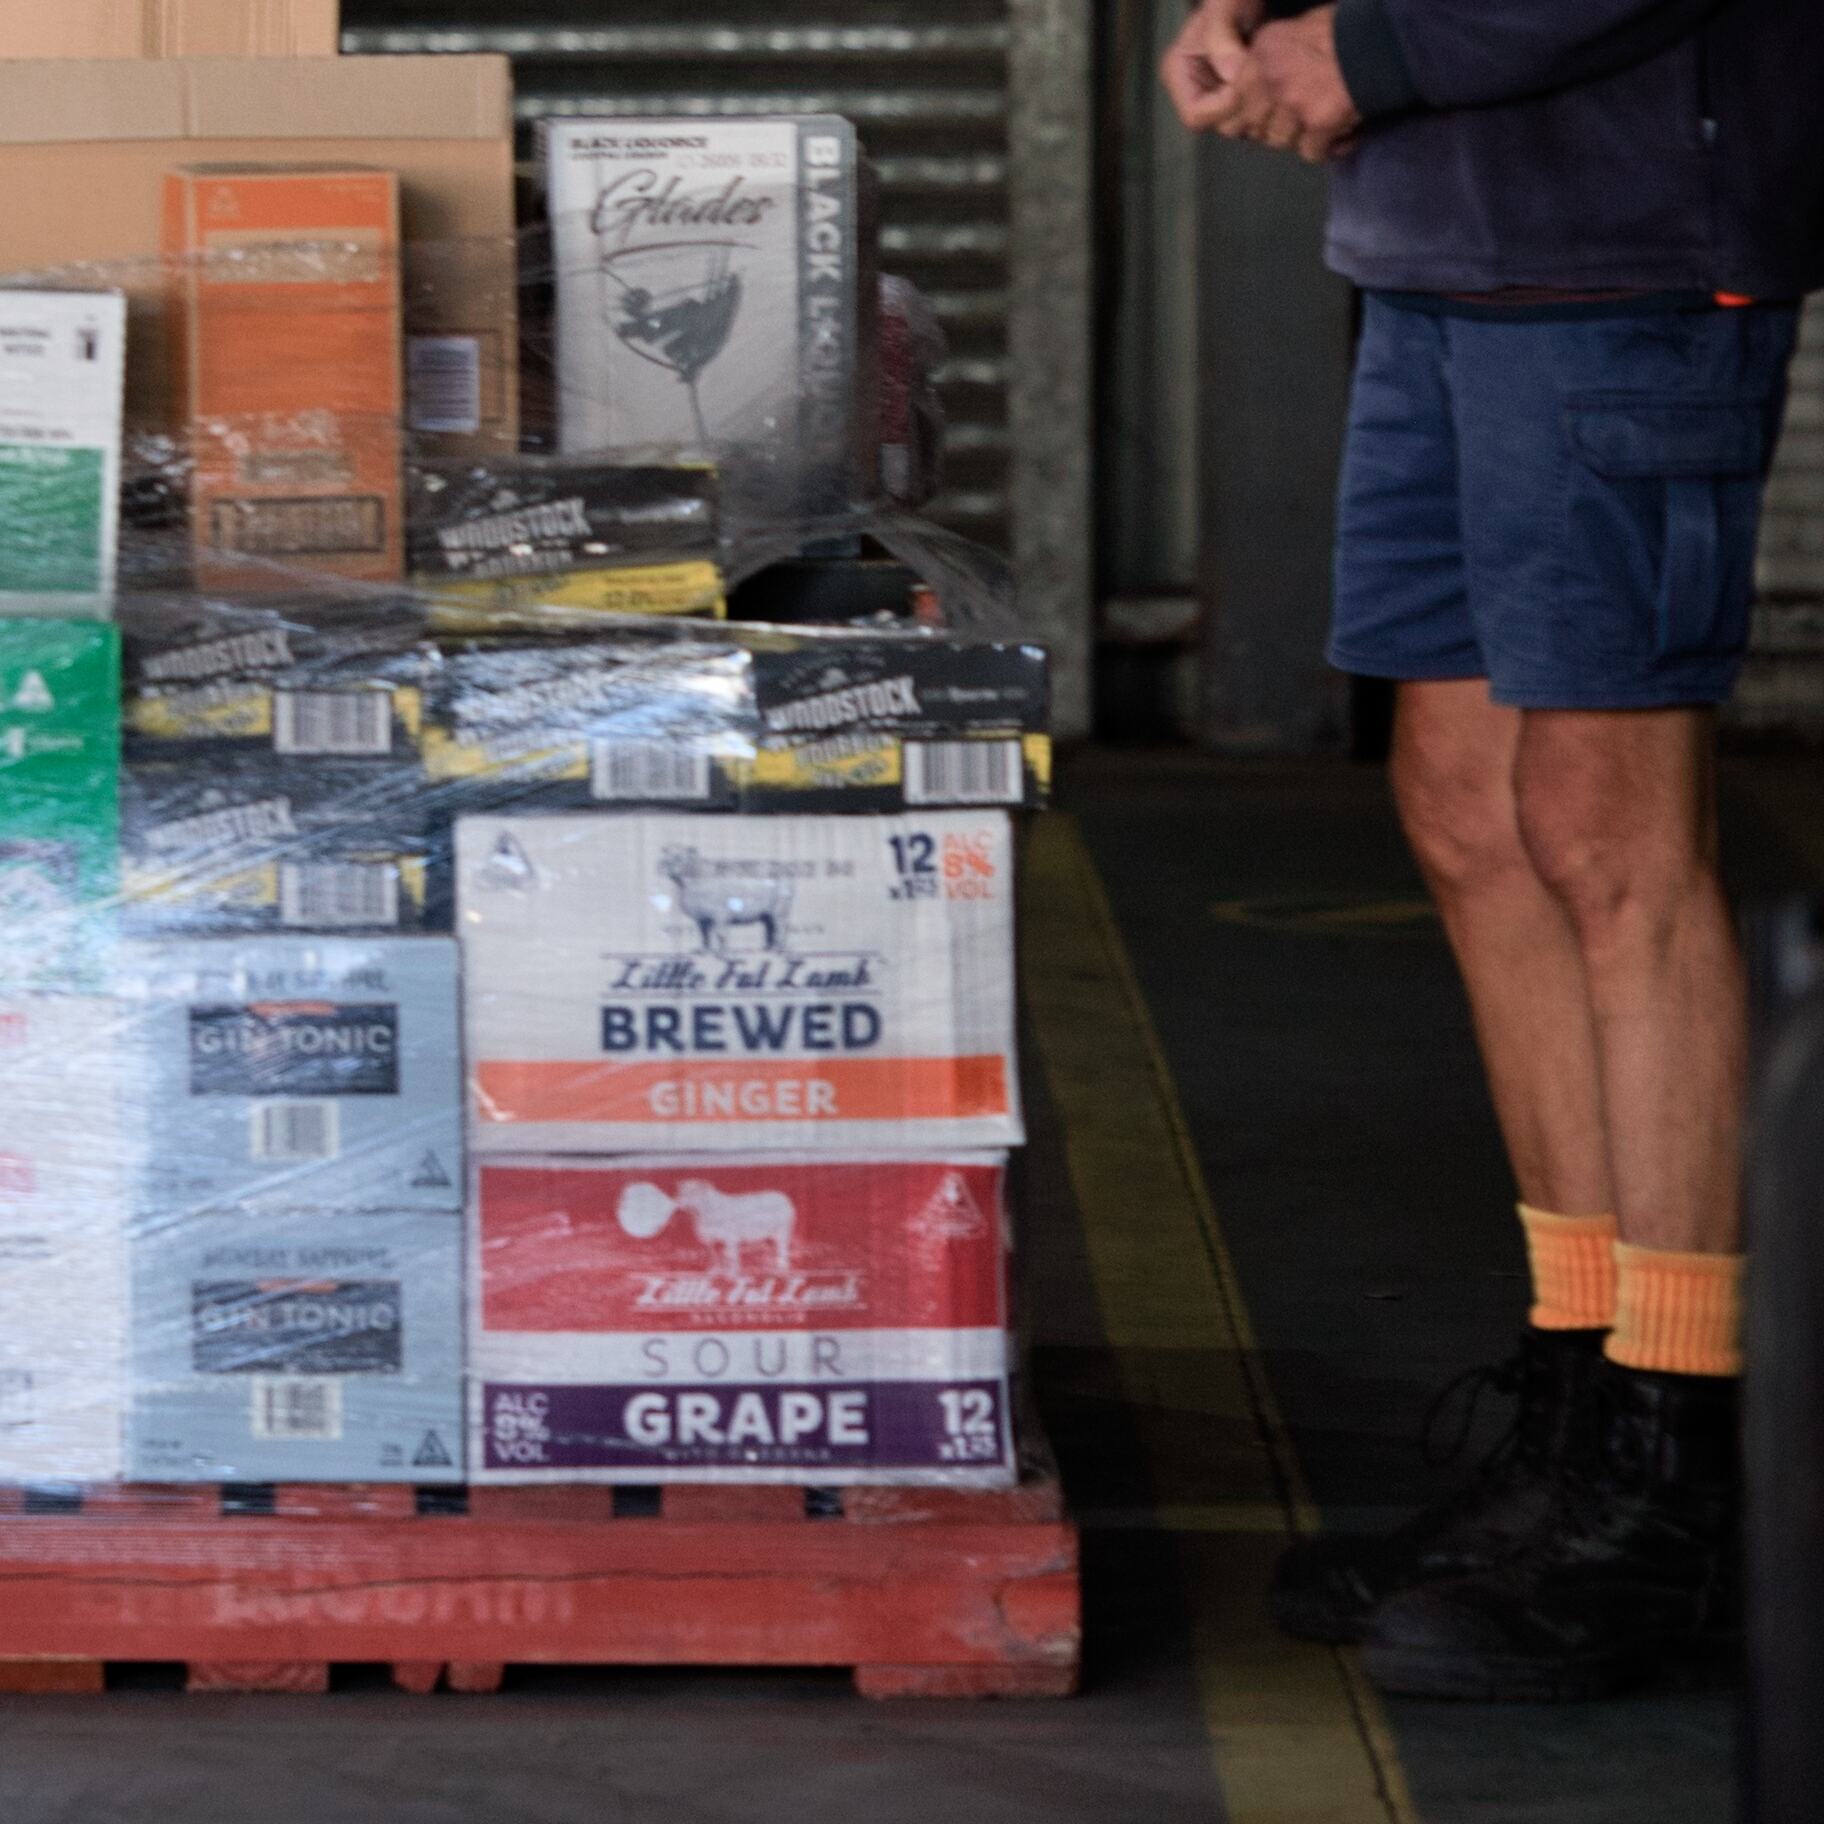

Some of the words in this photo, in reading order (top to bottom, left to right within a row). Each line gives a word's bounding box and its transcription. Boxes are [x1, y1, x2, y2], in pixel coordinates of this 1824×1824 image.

[804, 135, 842, 283] BLACK
[764, 675, 923, 748] WOODSTOCK
[888, 831, 936, 875] 12
[610, 956, 707, 991] Little
[775, 955, 873, 990] Lamb
[276, 1024, 394, 1054] TONIC
[600, 1002, 884, 1053] BREWED
[651, 1077, 839, 1118] GINGER
[635, 1275, 721, 1306] Little
[776, 1274, 860, 1305] Lamb
[641, 1336, 845, 1378] SOUR
[493, 1391, 551, 1417] ALC
[622, 1391, 870, 1447] GRAPE
[937, 1389, 996, 1436] 12
[493, 1440, 552, 1464] VOL
